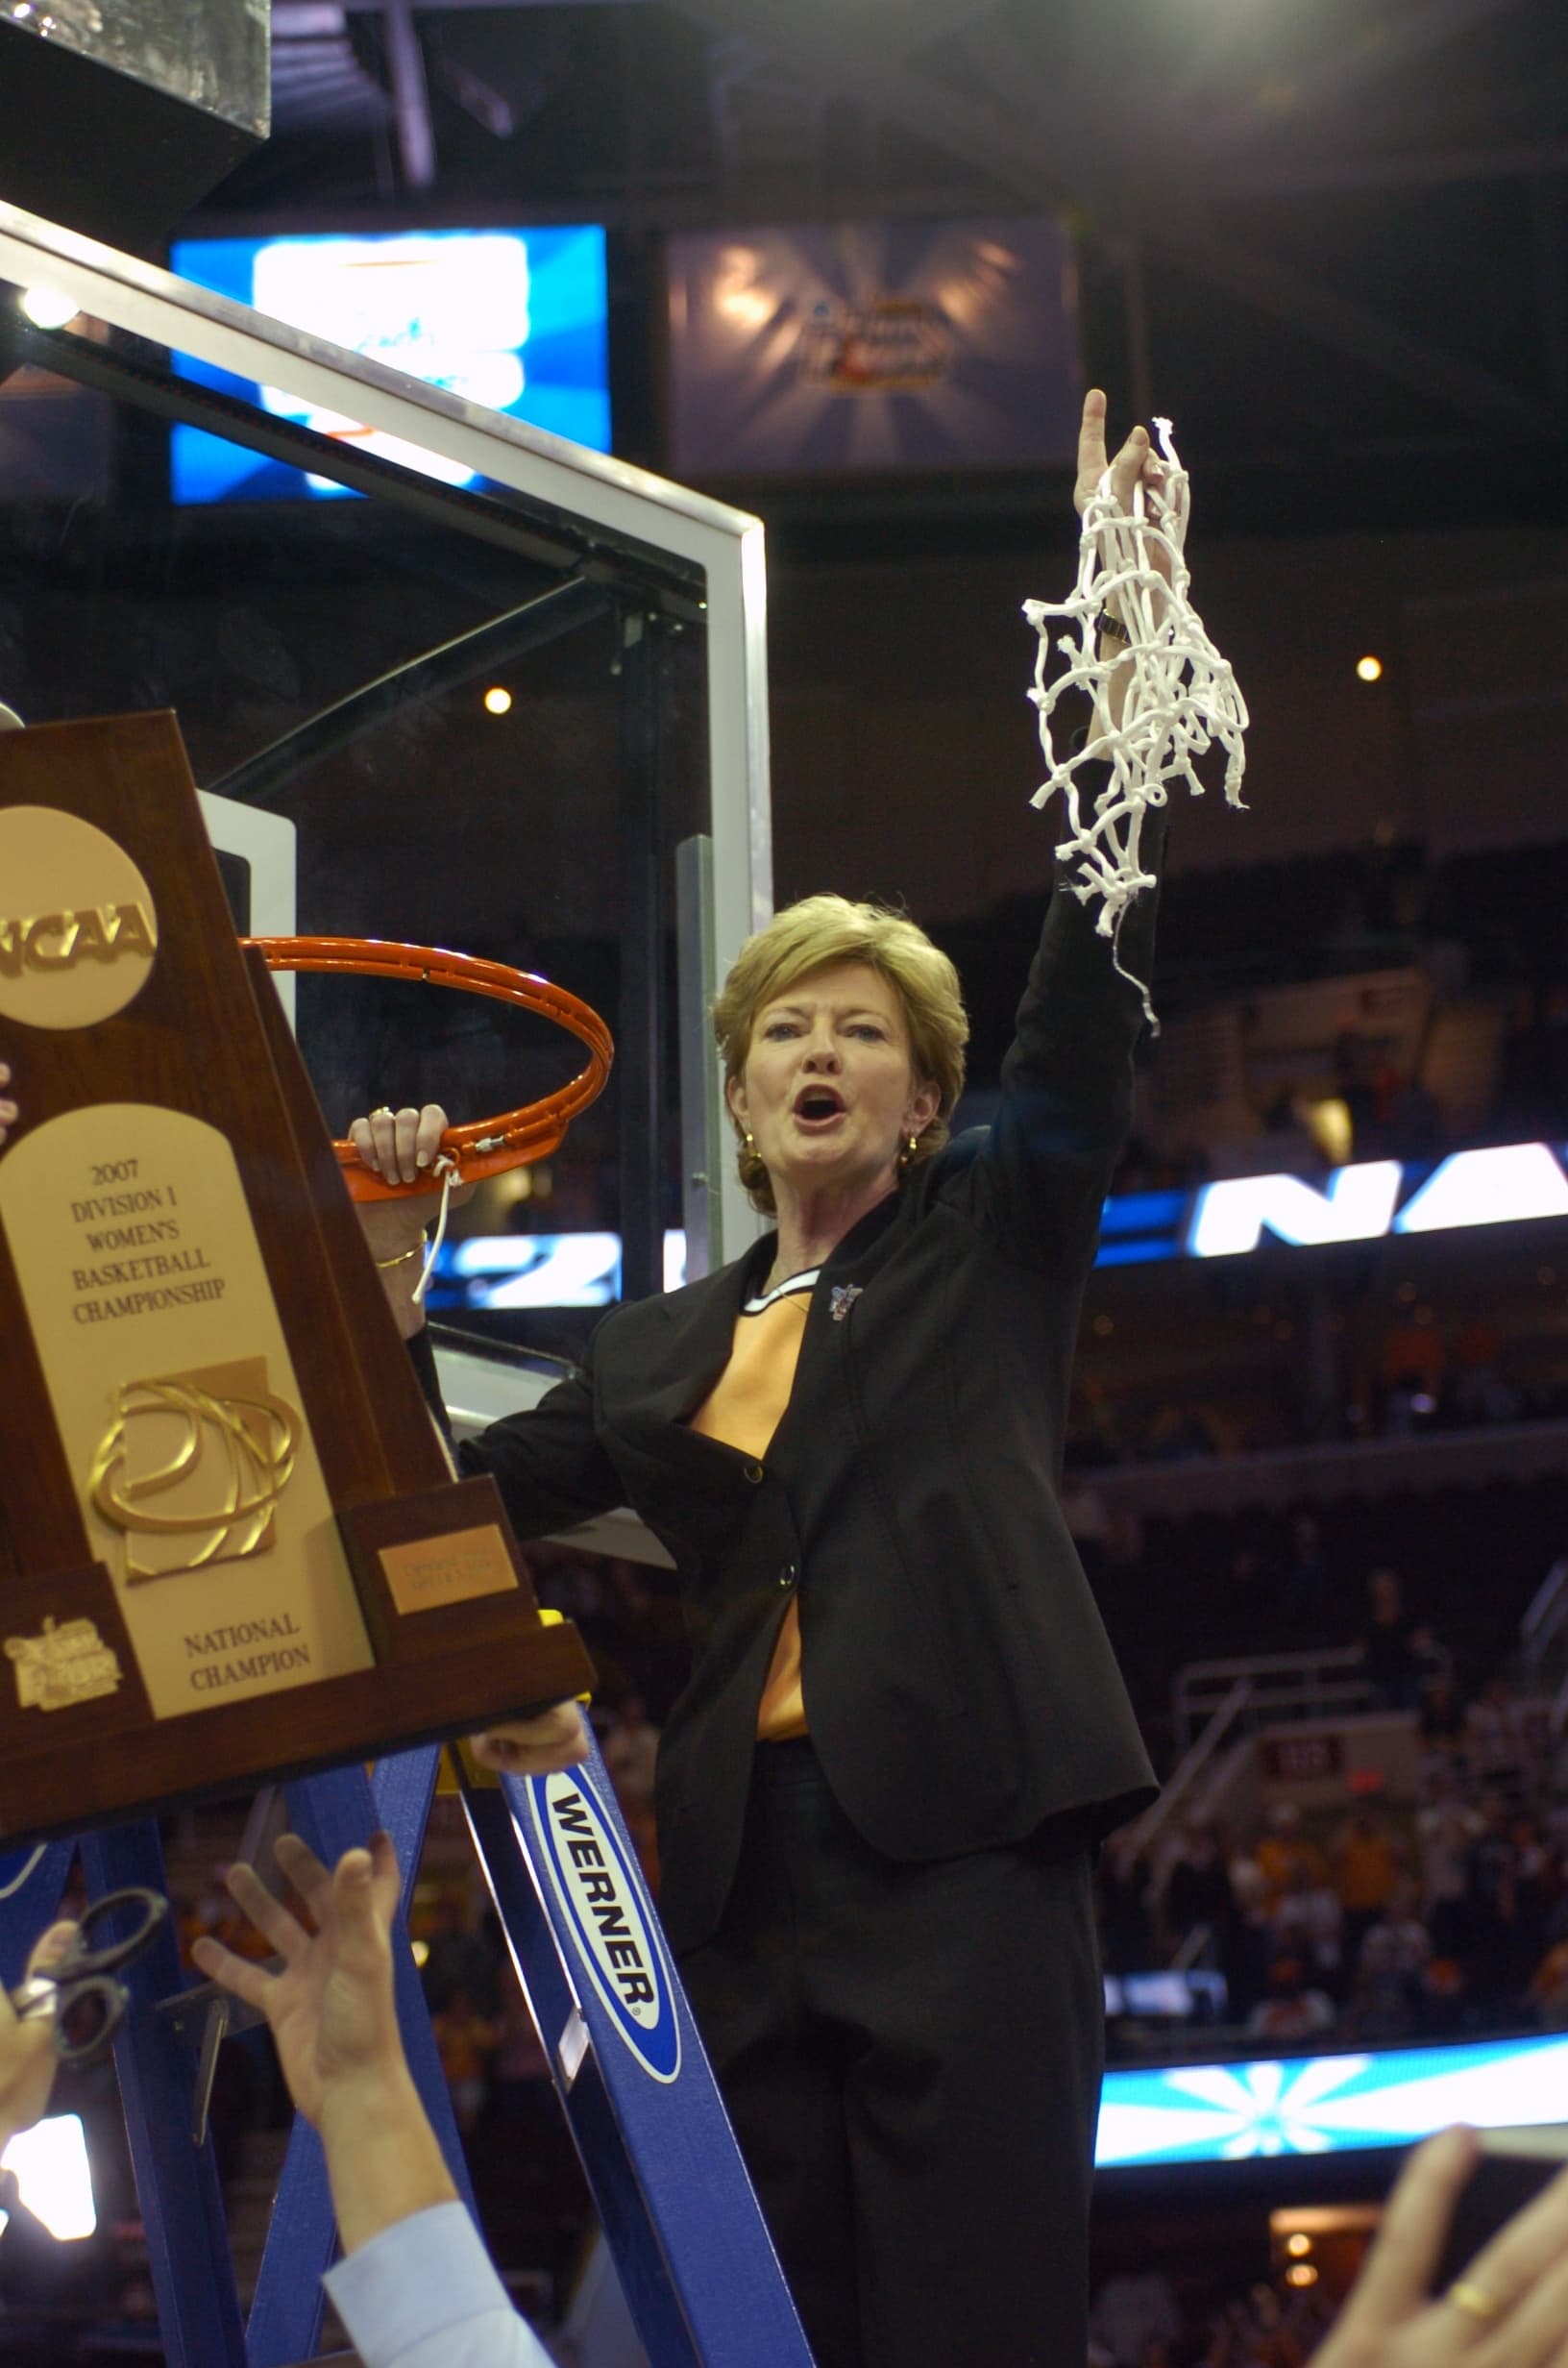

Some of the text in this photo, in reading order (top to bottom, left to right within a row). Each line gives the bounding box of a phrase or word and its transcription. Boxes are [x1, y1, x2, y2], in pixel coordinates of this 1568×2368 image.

[90, 1158, 138, 1186] 2007
[71, 1185, 178, 1223] DIVISION I
[86, 1219, 180, 1252] WOMEN'S
[72, 1247, 210, 1291] BASKETBALL
[73, 1278, 226, 1324] CHAMPIONSHIP
[184, 1613, 301, 1659] NATIONAL
[189, 1644, 310, 1690] CHAMPION
[551, 1784, 655, 2006] WERNER
